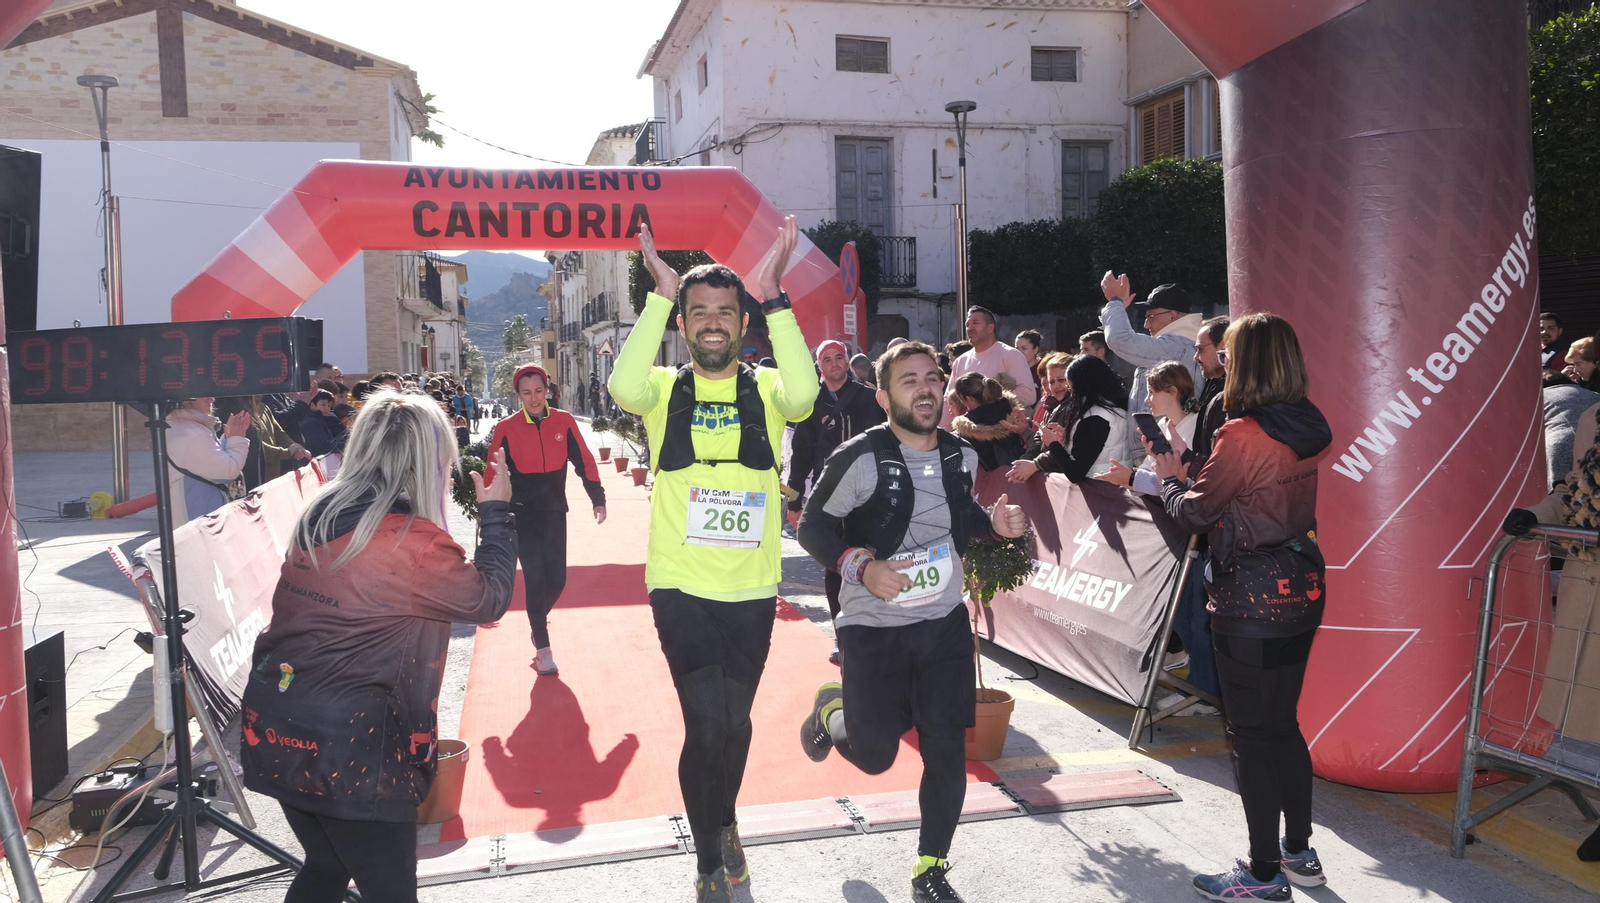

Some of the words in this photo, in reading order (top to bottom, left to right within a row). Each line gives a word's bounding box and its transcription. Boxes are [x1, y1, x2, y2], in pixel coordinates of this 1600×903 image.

[403, 167, 662, 191] AYUNTAMIENTO
[412, 200, 654, 239] CANTORIA
[1331, 195, 1537, 483] www.teamergy.es
[701, 488, 710, 496] IV
[712, 489, 730, 497] CxM
[708, 497, 742, 506] PÓLVORA
[703, 508, 750, 533] 266
[1265, 597, 1301, 605] COSENTINO
[277, 735, 318, 750] VEOLIA
